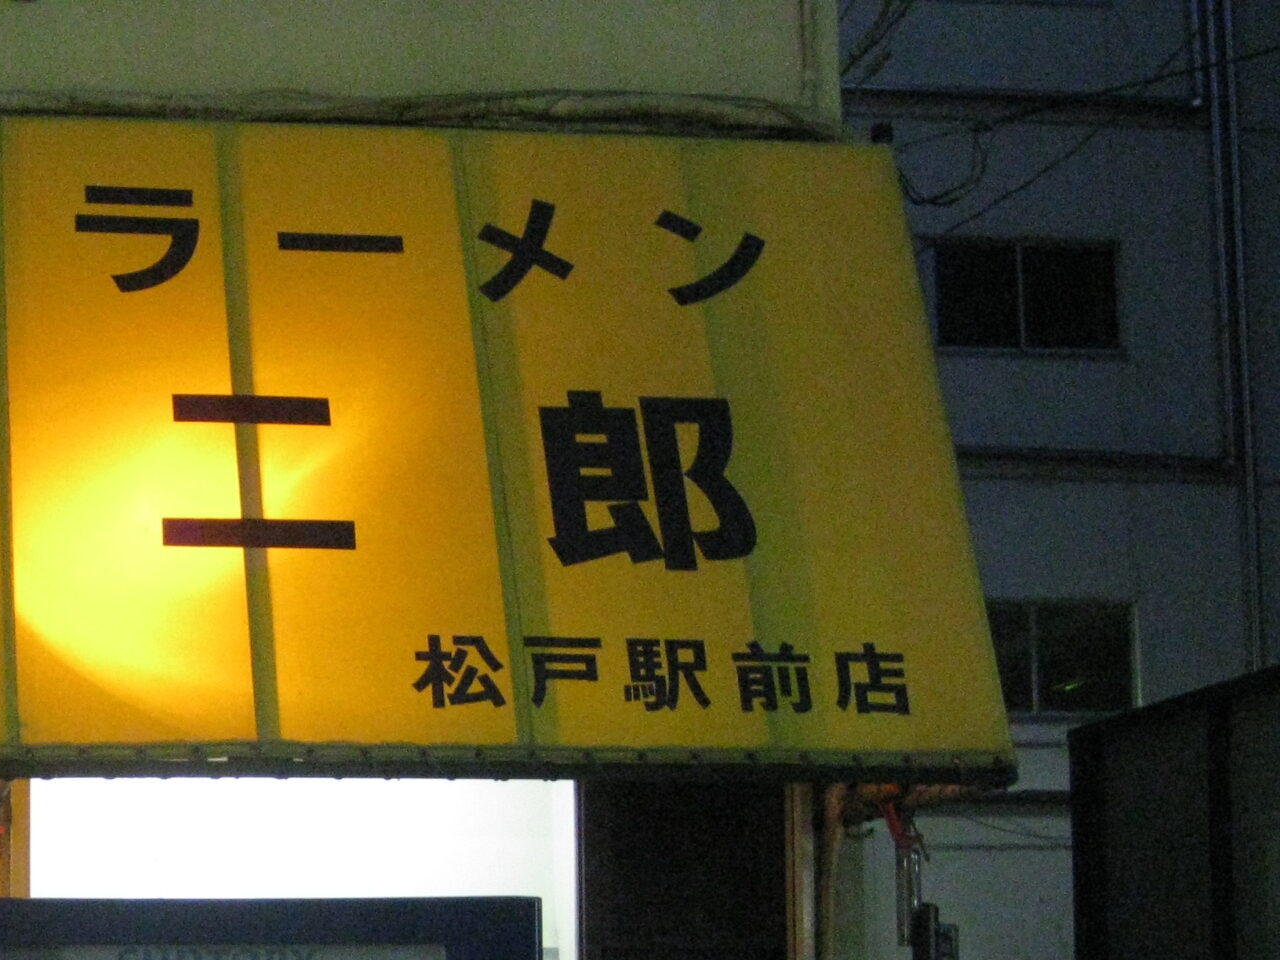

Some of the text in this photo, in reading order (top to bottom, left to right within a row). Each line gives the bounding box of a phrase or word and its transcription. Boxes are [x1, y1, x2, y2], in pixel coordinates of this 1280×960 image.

[74, 184, 766, 307] ラーメン
[161, 389, 758, 572] 二郎
[412, 633, 912, 716] 松戸駅前店
